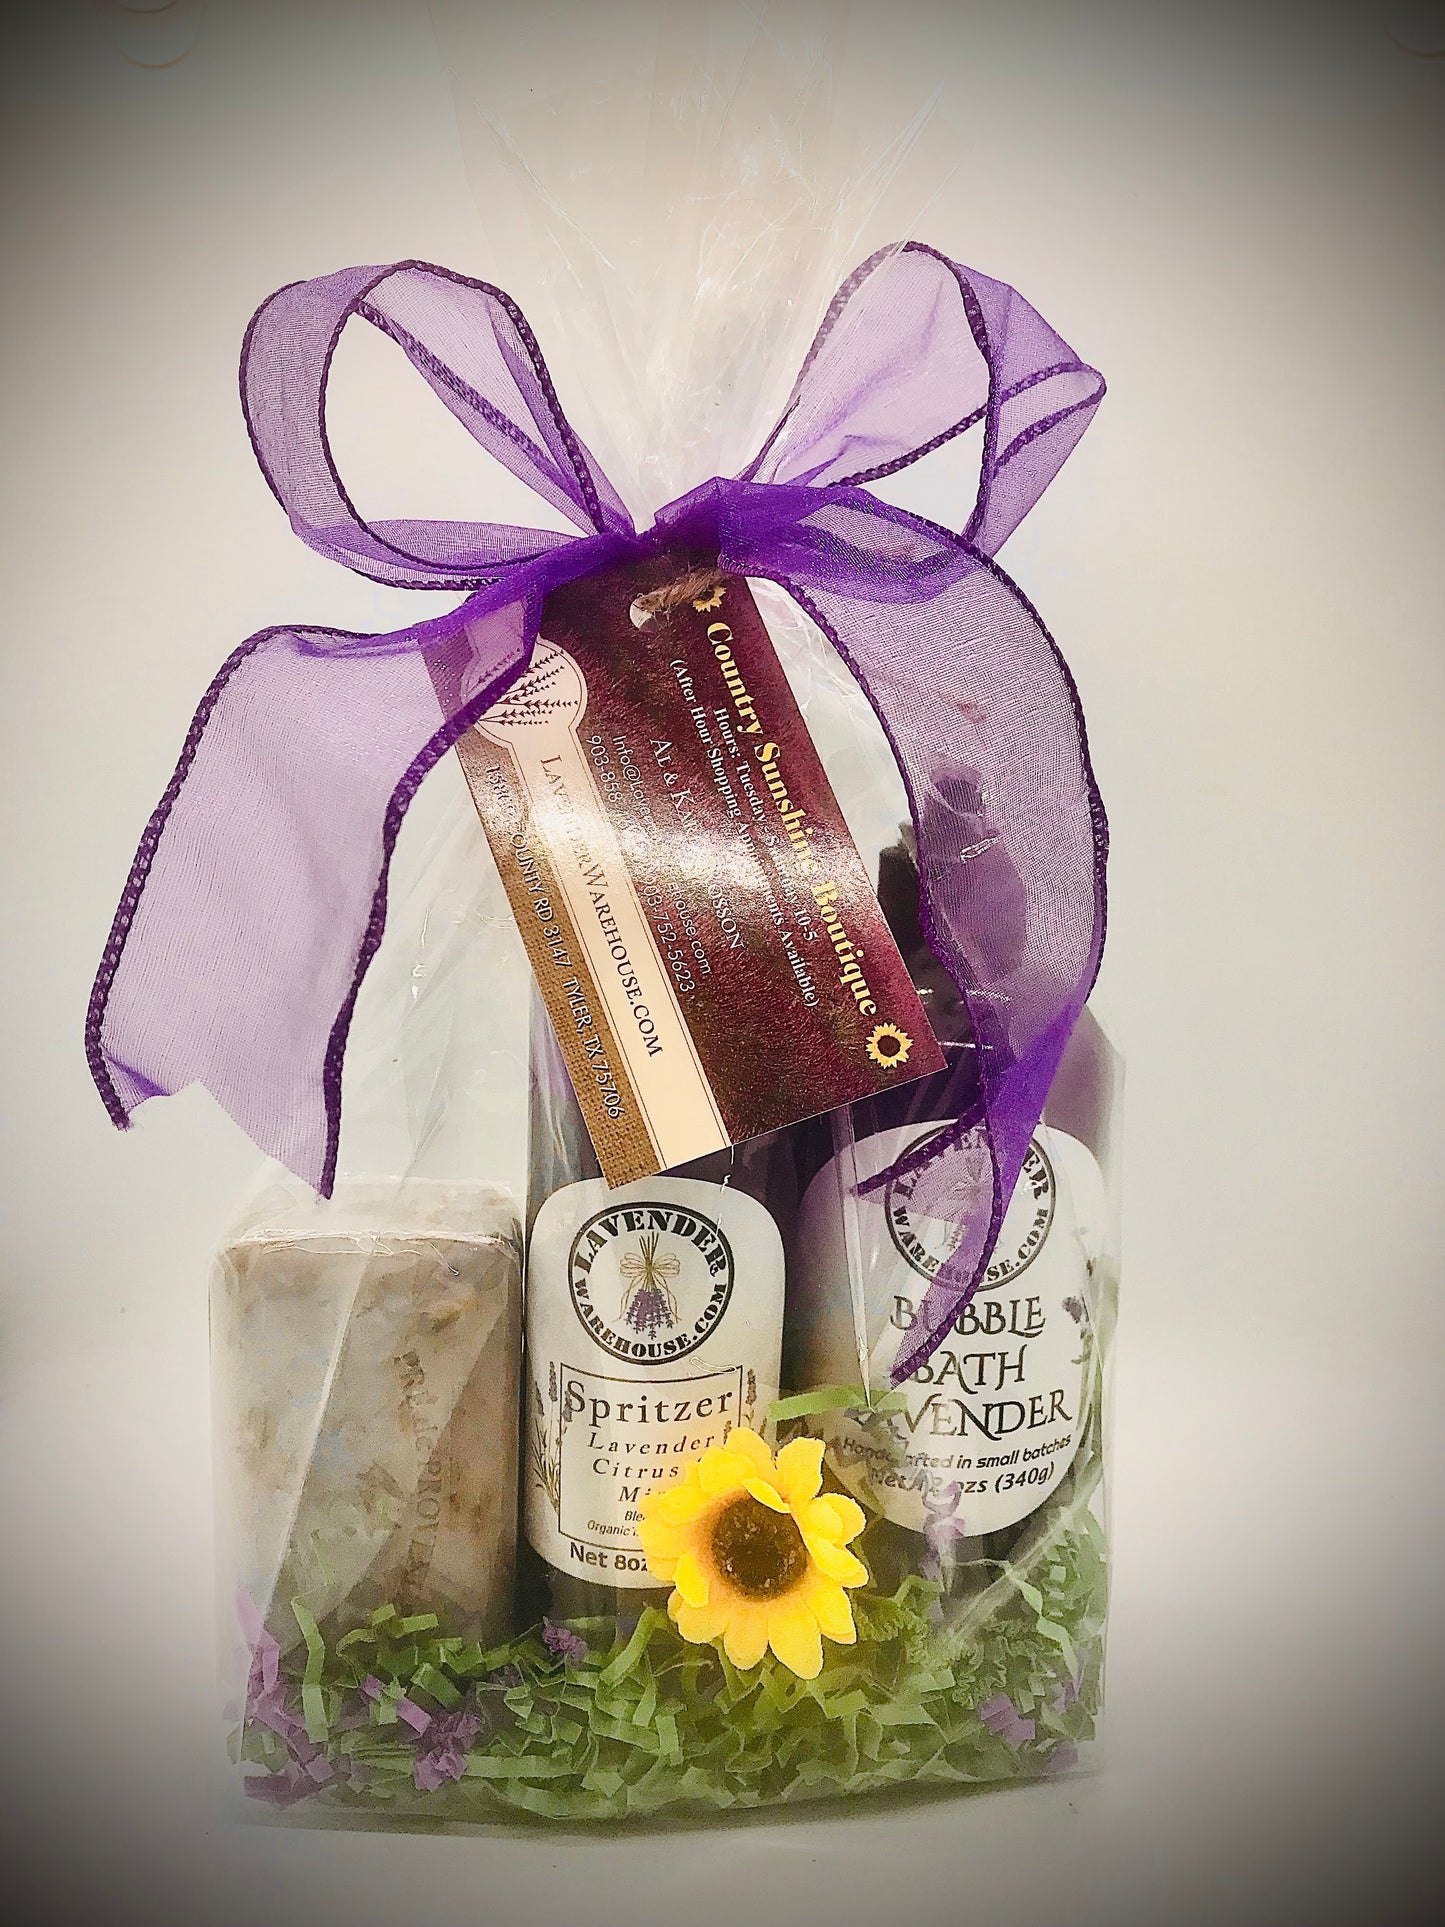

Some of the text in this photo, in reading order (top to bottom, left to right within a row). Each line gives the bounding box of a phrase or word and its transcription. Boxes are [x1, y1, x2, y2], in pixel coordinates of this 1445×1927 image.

[667, 657, 700, 704] (After
[689, 706, 717, 747] Hour
[661, 769, 682, 787] &
[702, 747, 745, 819] Shopping
[705, 620, 878, 1017] Country Sunshine Boutique
[711, 707, 745, 759] Hours:
[732, 759, 767, 823] Tuesday
[791, 907, 818, 942] 10-5
[531, 895, 555, 923] RD
[541, 923, 572, 972] 3147
[775, 927, 821, 1009] Available)
[558, 975, 596, 1036] TYLER,
[580, 1033, 605, 1060] TX
[589, 1058, 627, 1120] 75706
[574, 1210, 727, 1277] LAVENDER
[574, 1278, 727, 1358] WAREHOUSE.COM
[567, 1380, 733, 1428] Spritzer
[587, 1432, 715, 1455] Lavender
[956, 1454, 972, 1470] in
[975, 1449, 1020, 1469] small
[1022, 1432, 1072, 1463] batches
[592, 1458, 679, 1480] Citrus
[994, 1461, 1055, 1494] (340g)
[587, 1519, 631, 1537] Organic
[569, 1541, 608, 1569] Net
